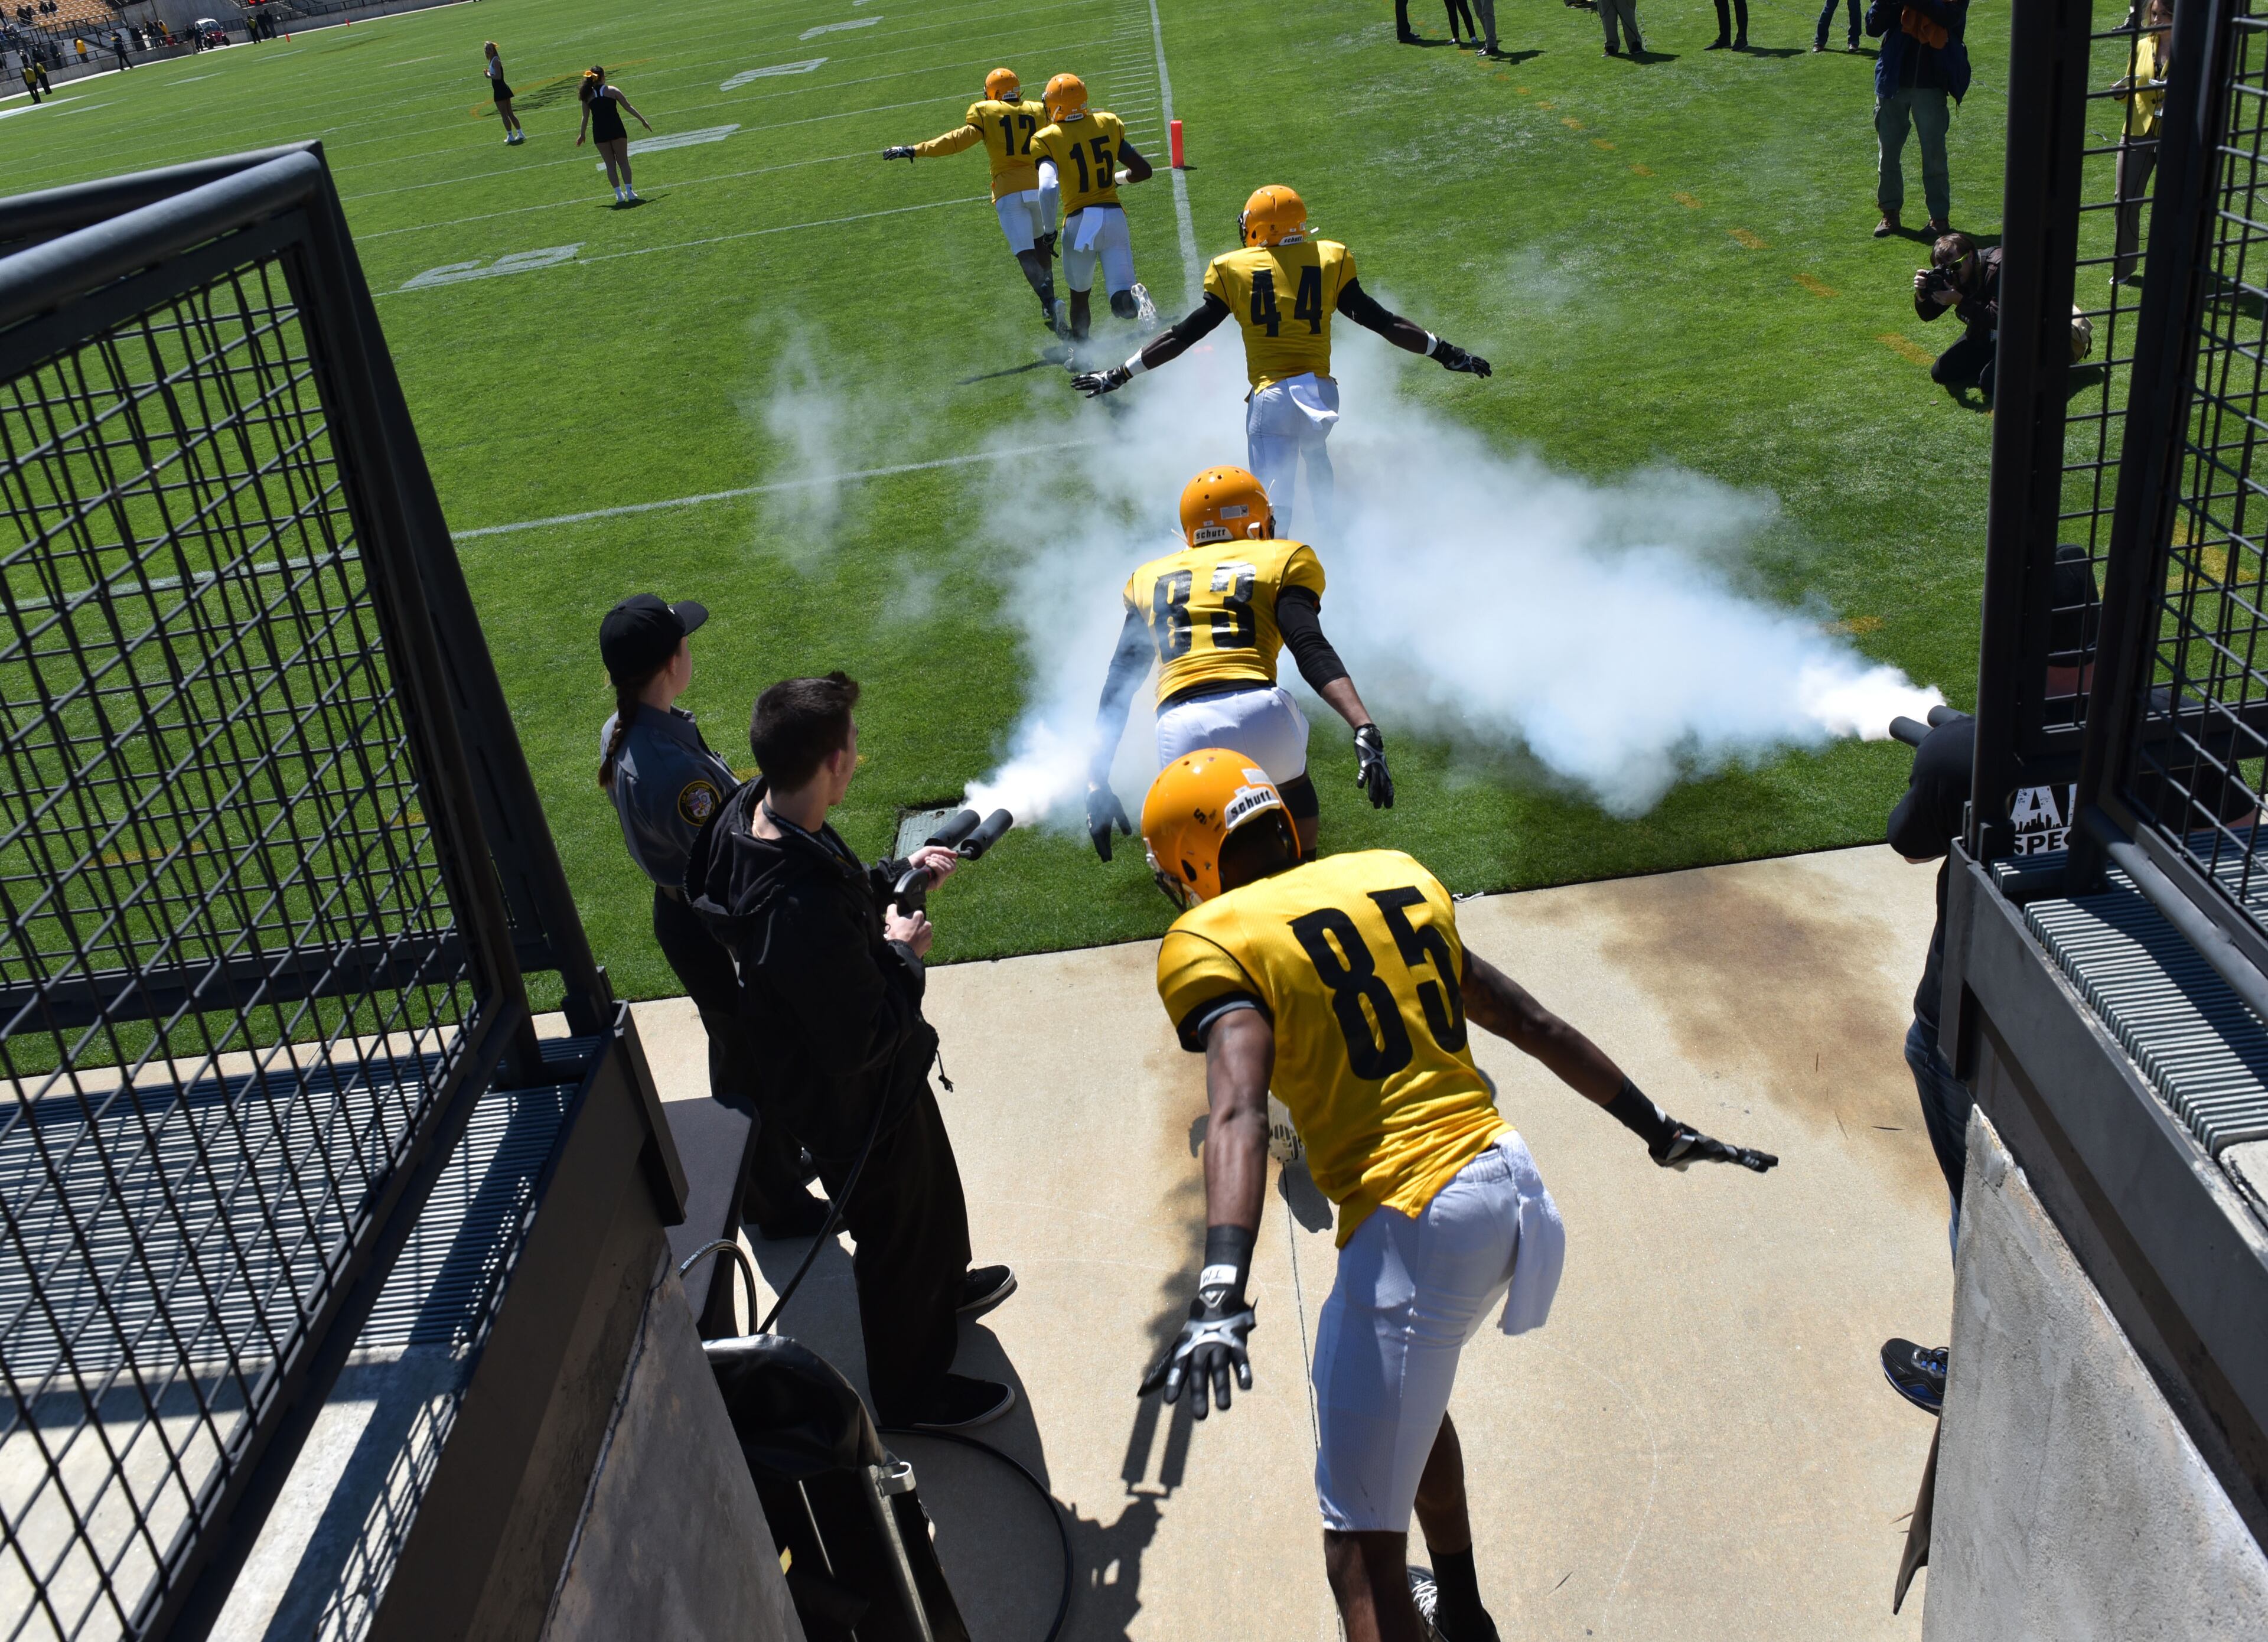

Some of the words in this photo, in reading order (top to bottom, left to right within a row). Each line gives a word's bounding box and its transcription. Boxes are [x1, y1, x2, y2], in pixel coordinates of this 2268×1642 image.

[999, 114, 1037, 156] 12
[1069, 135, 1114, 193] 15
[1250, 265, 1324, 337] 44
[1196, 529, 1226, 539] schutt
[1152, 562, 1257, 664] 83
[1230, 790, 1272, 818] schutt
[1287, 885, 1468, 1080] 85
